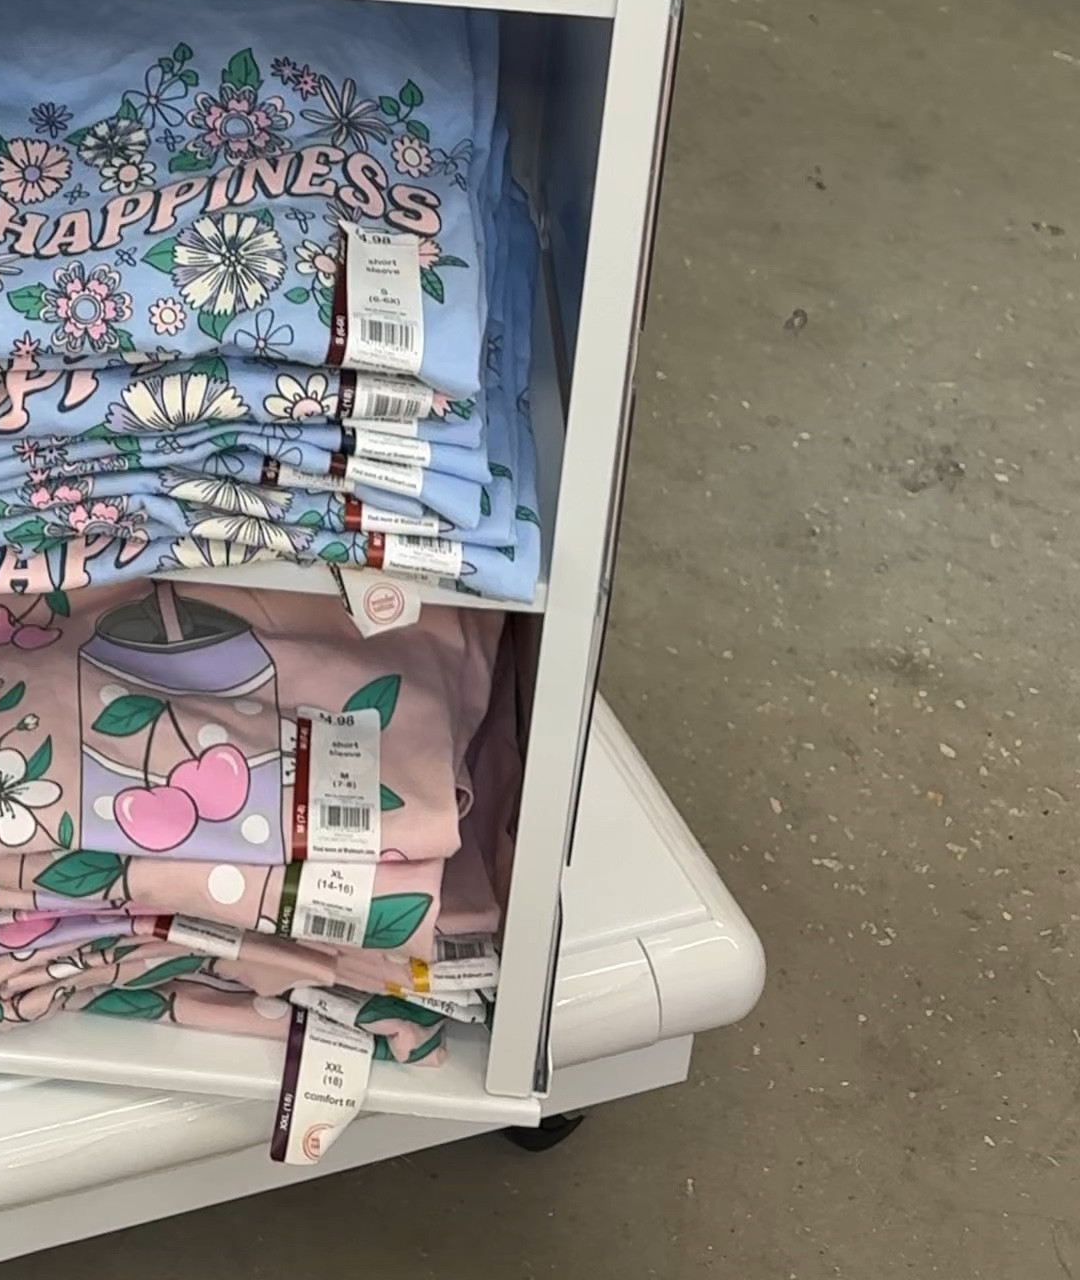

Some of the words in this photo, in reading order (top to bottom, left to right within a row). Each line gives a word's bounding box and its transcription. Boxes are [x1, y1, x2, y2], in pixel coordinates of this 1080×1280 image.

[330, 869, 344, 880] XL
[317, 878, 354, 896] (14-16)
[324, 1061, 344, 1075] XXL
[303, 1091, 344, 1107] comfort
[345, 1097, 356, 1109] fit
[279, 1113, 290, 1131] XXL
